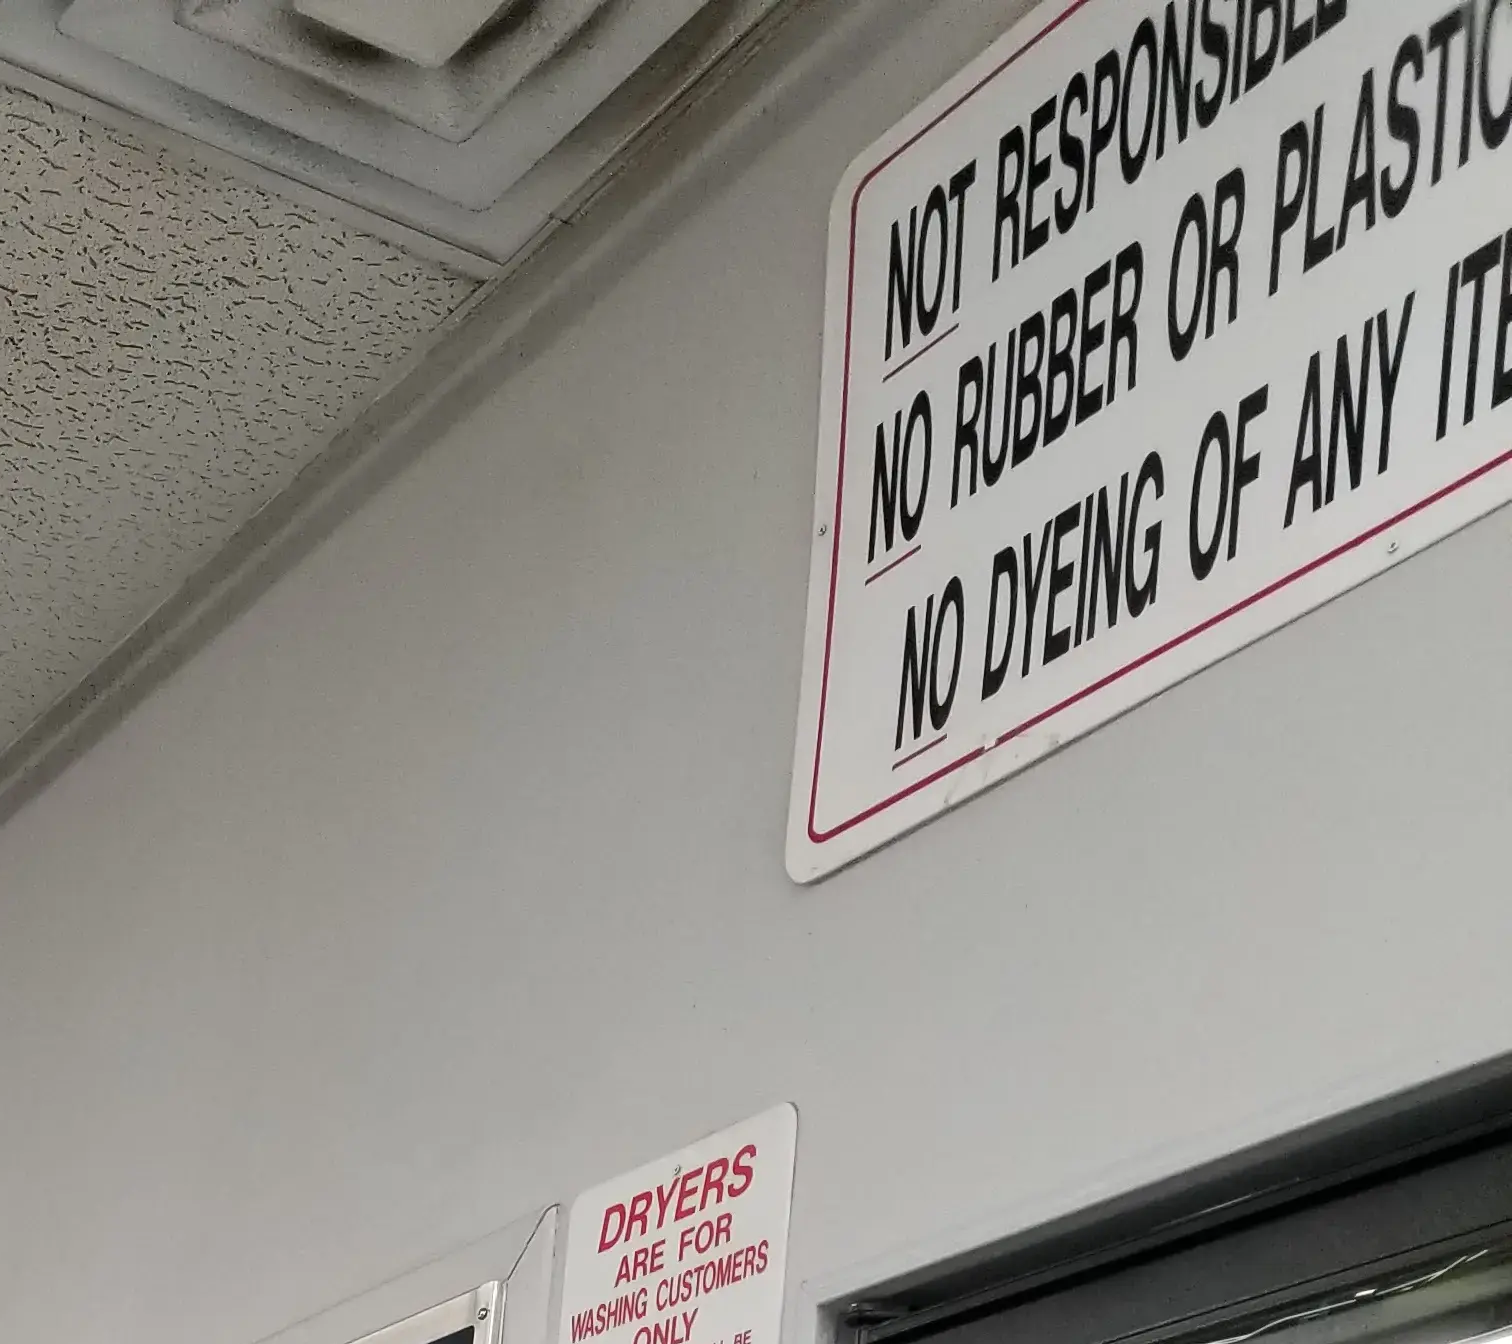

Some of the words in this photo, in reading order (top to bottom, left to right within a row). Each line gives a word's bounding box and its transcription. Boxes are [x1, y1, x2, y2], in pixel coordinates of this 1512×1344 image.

[883, 158, 977, 362] NOT
[991, 0, 1347, 281] RESPONSIB
[867, 390, 932, 564] NO
[950, 239, 1144, 510] RUBBER
[1167, 165, 1245, 362] OR
[894, 575, 965, 751] NO
[981, 450, 1165, 702] DYEING
[1189, 383, 1268, 580] OF
[1284, 290, 1416, 531] ANY
[570, 1288, 648, 1344] WASHING
[656, 1239, 770, 1312] CUSTOMERS
[597, 1144, 757, 1253] DRYERS
[614, 1239, 666, 1288] ARE
[678, 1212, 733, 1262] FOR
